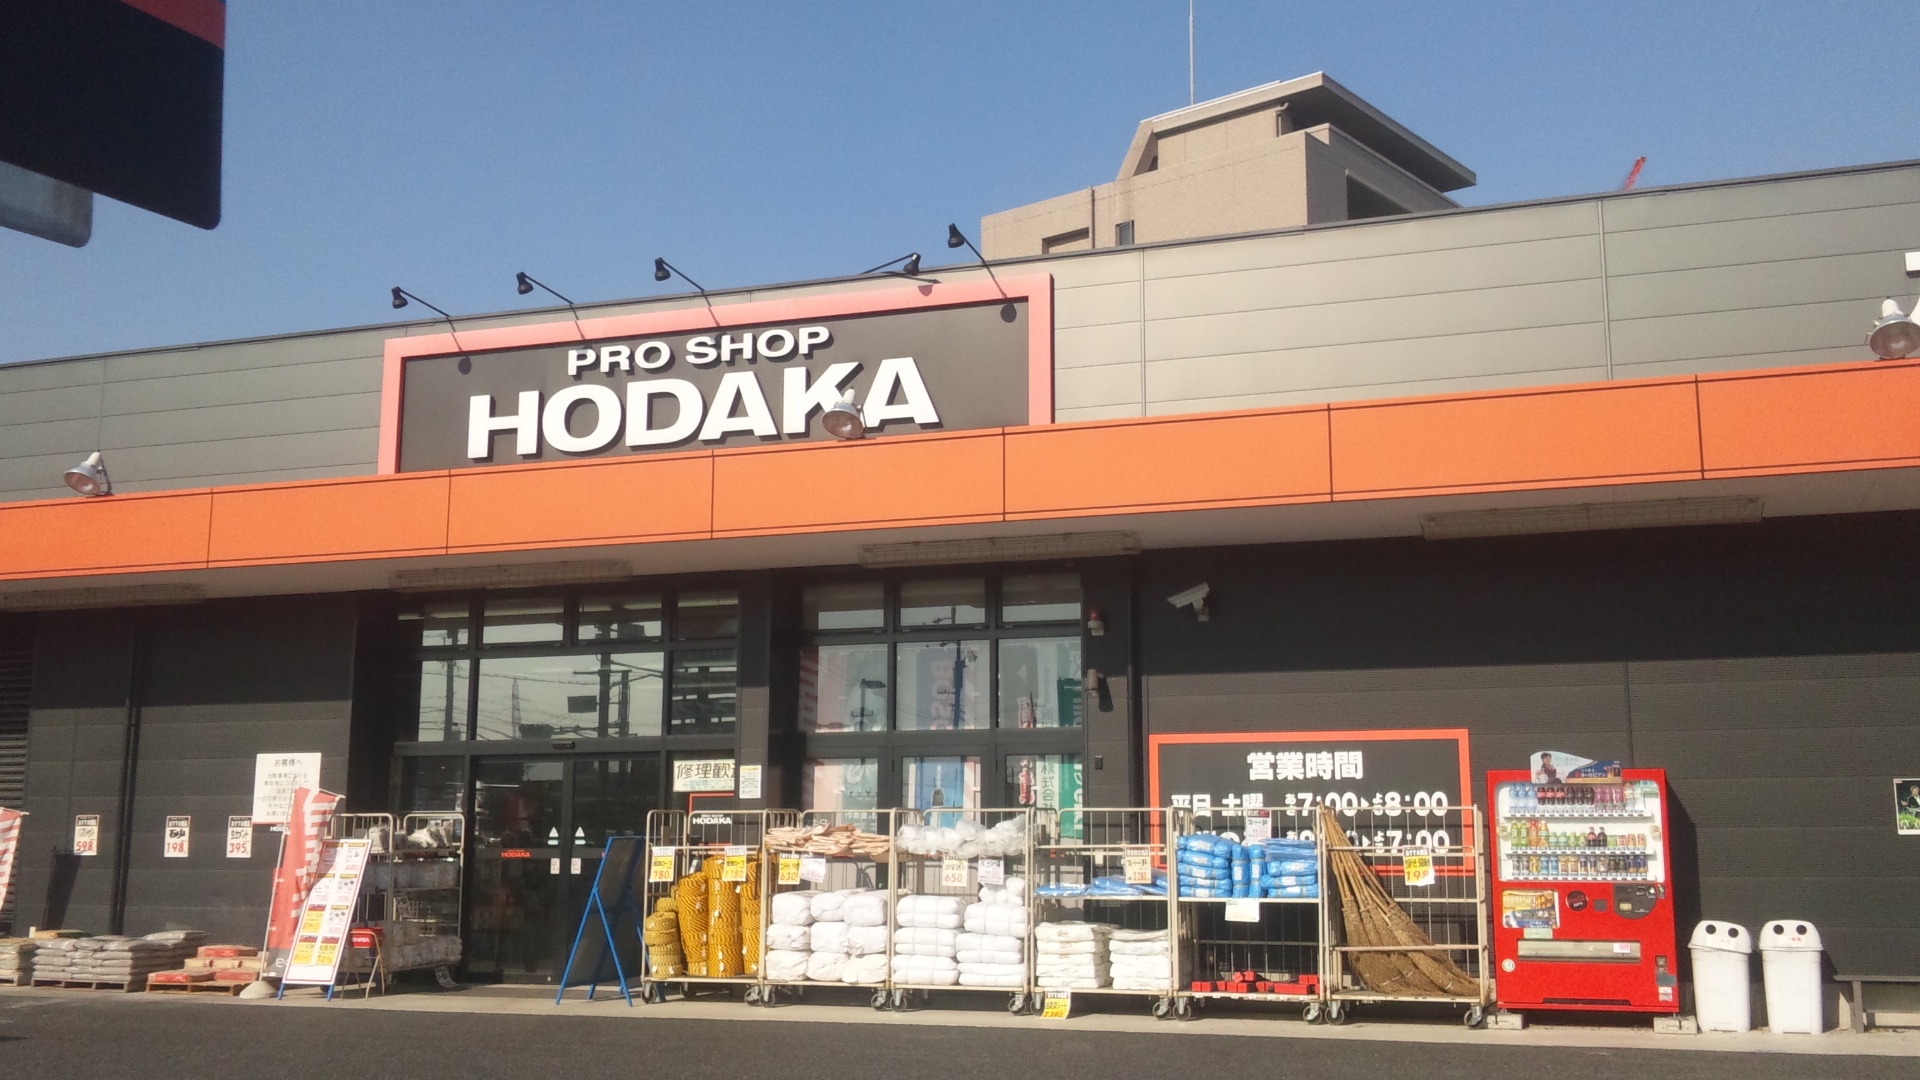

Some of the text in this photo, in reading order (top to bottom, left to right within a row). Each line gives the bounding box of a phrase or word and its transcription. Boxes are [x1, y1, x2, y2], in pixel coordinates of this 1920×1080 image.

[567, 325, 831, 376] PRO SHOP
[466, 356, 940, 459] HODAKA
[1246, 751, 1364, 780] 営業時間
[1171, 794, 1211, 817] 平日
[692, 817, 732, 825] HODAKA
[166, 842, 184, 853] 198
[229, 843, 247, 854] 395
[653, 870, 669, 879] 780
[780, 872, 797, 881] 630
[944, 873, 963, 883] 650
